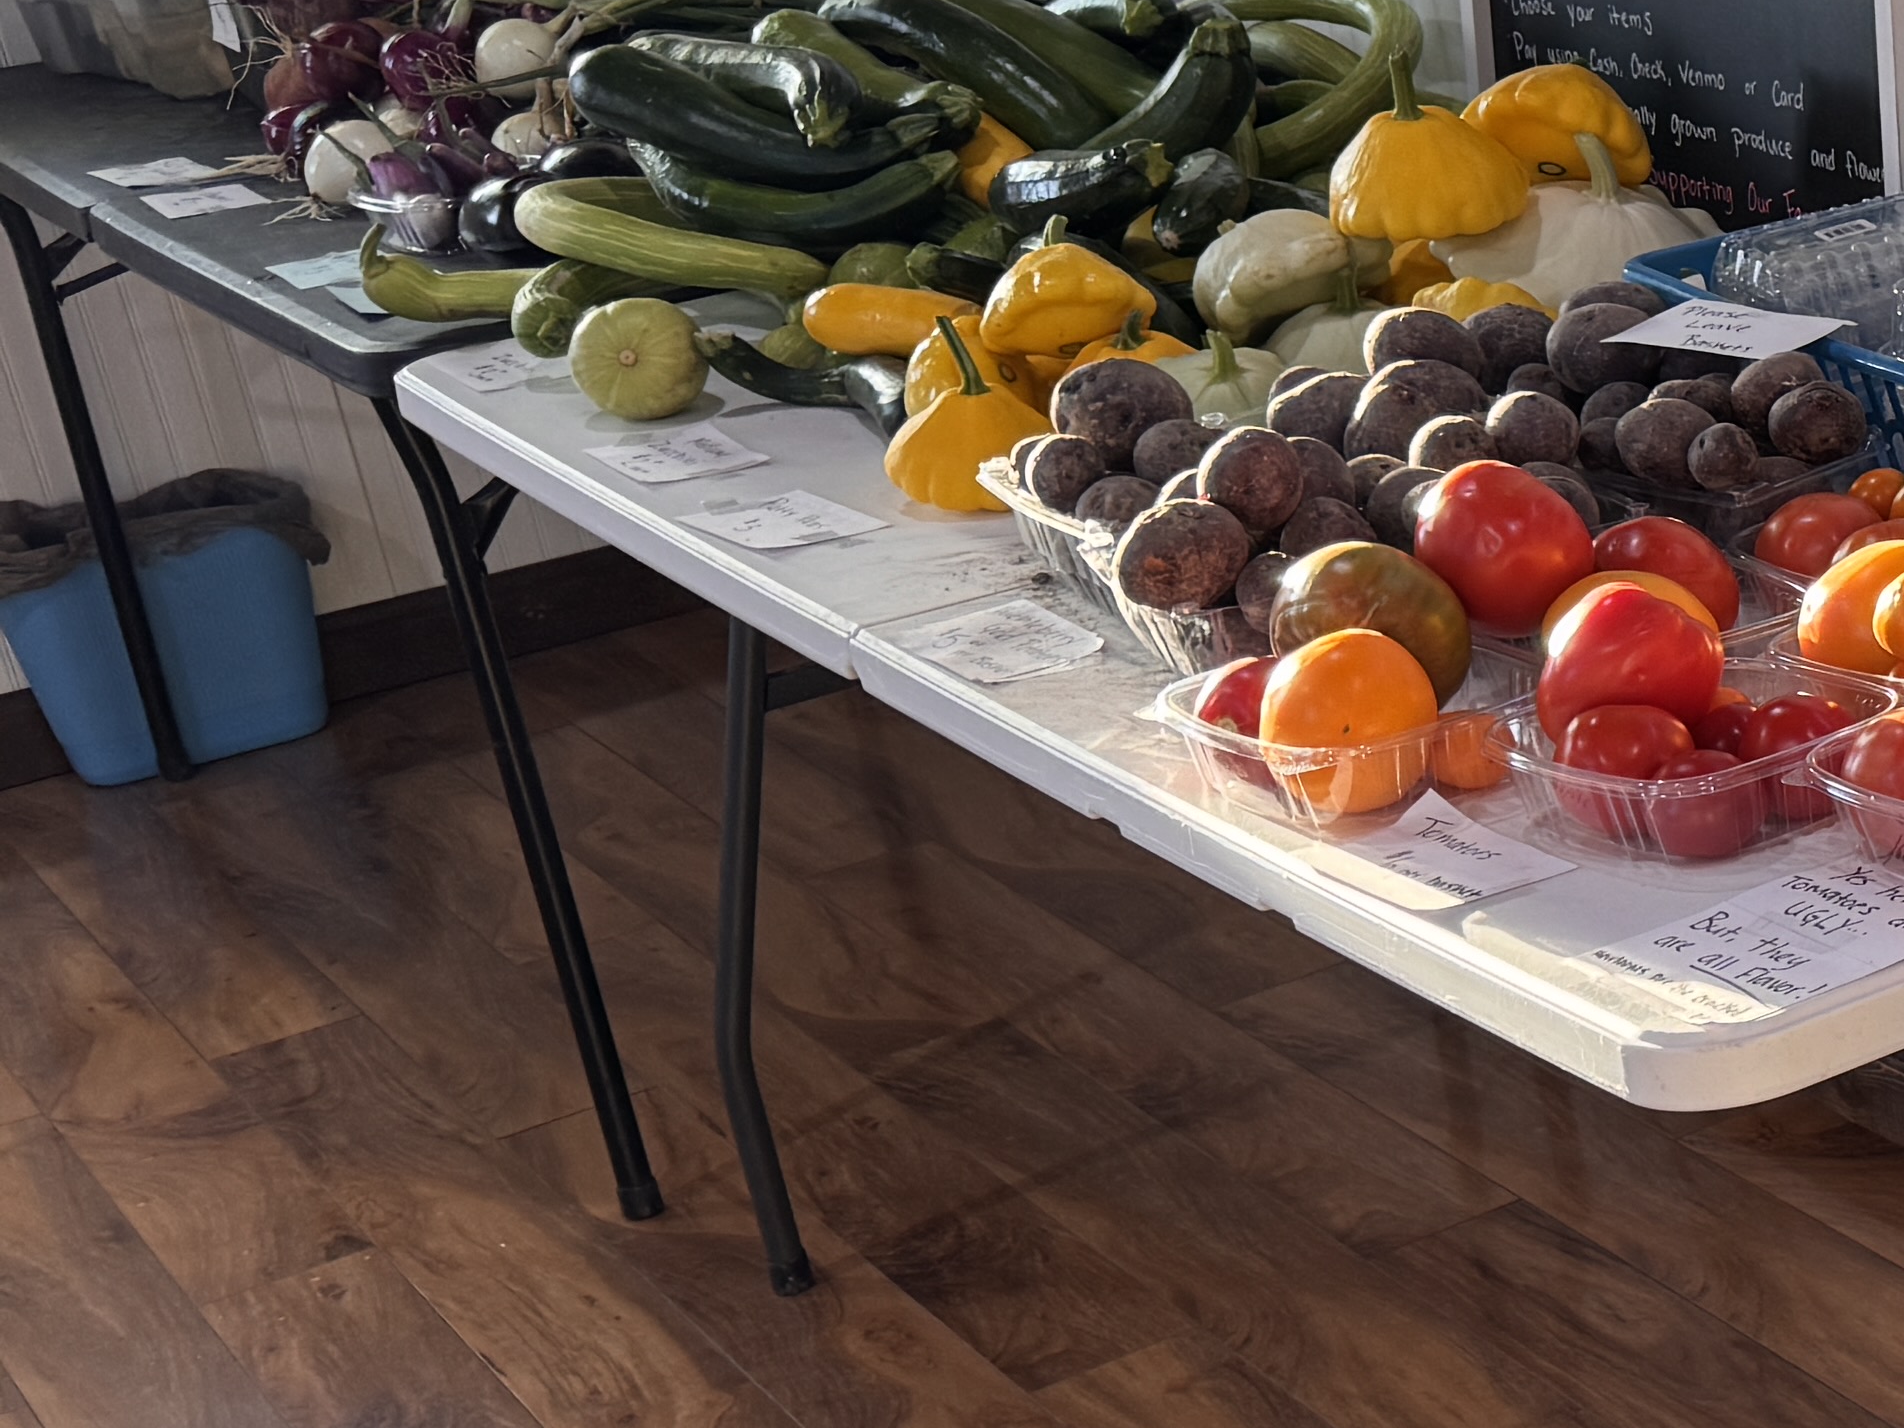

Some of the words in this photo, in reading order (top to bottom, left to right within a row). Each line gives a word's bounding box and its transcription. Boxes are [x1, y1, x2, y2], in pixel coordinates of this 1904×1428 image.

[1567, 4, 1594, 28] your
[1607, 4, 1653, 36] items
[1513, 31, 1538, 66] Pay
[1630, 52, 1672, 87] Check,
[1677, 60, 1726, 91] Venmo
[1744, 80, 1757, 96] or
[1772, 79, 1804, 111] Card
[1632, 106, 1656, 137] ally
[1671, 114, 1718, 147] grown
[1732, 127, 1794, 160] produce
[1810, 148, 1836, 171] and
[1845, 150, 1884, 183] flowe
[1747, 181, 1773, 213] Our
[1680, 305, 1752, 319] Please
[1654, 934, 1694, 952] are
[1698, 950, 1738, 970] all
[1740, 967, 1828, 1000] Flavor!
[1689, 910, 1742, 942] But,
[1748, 936, 1810, 971] they
